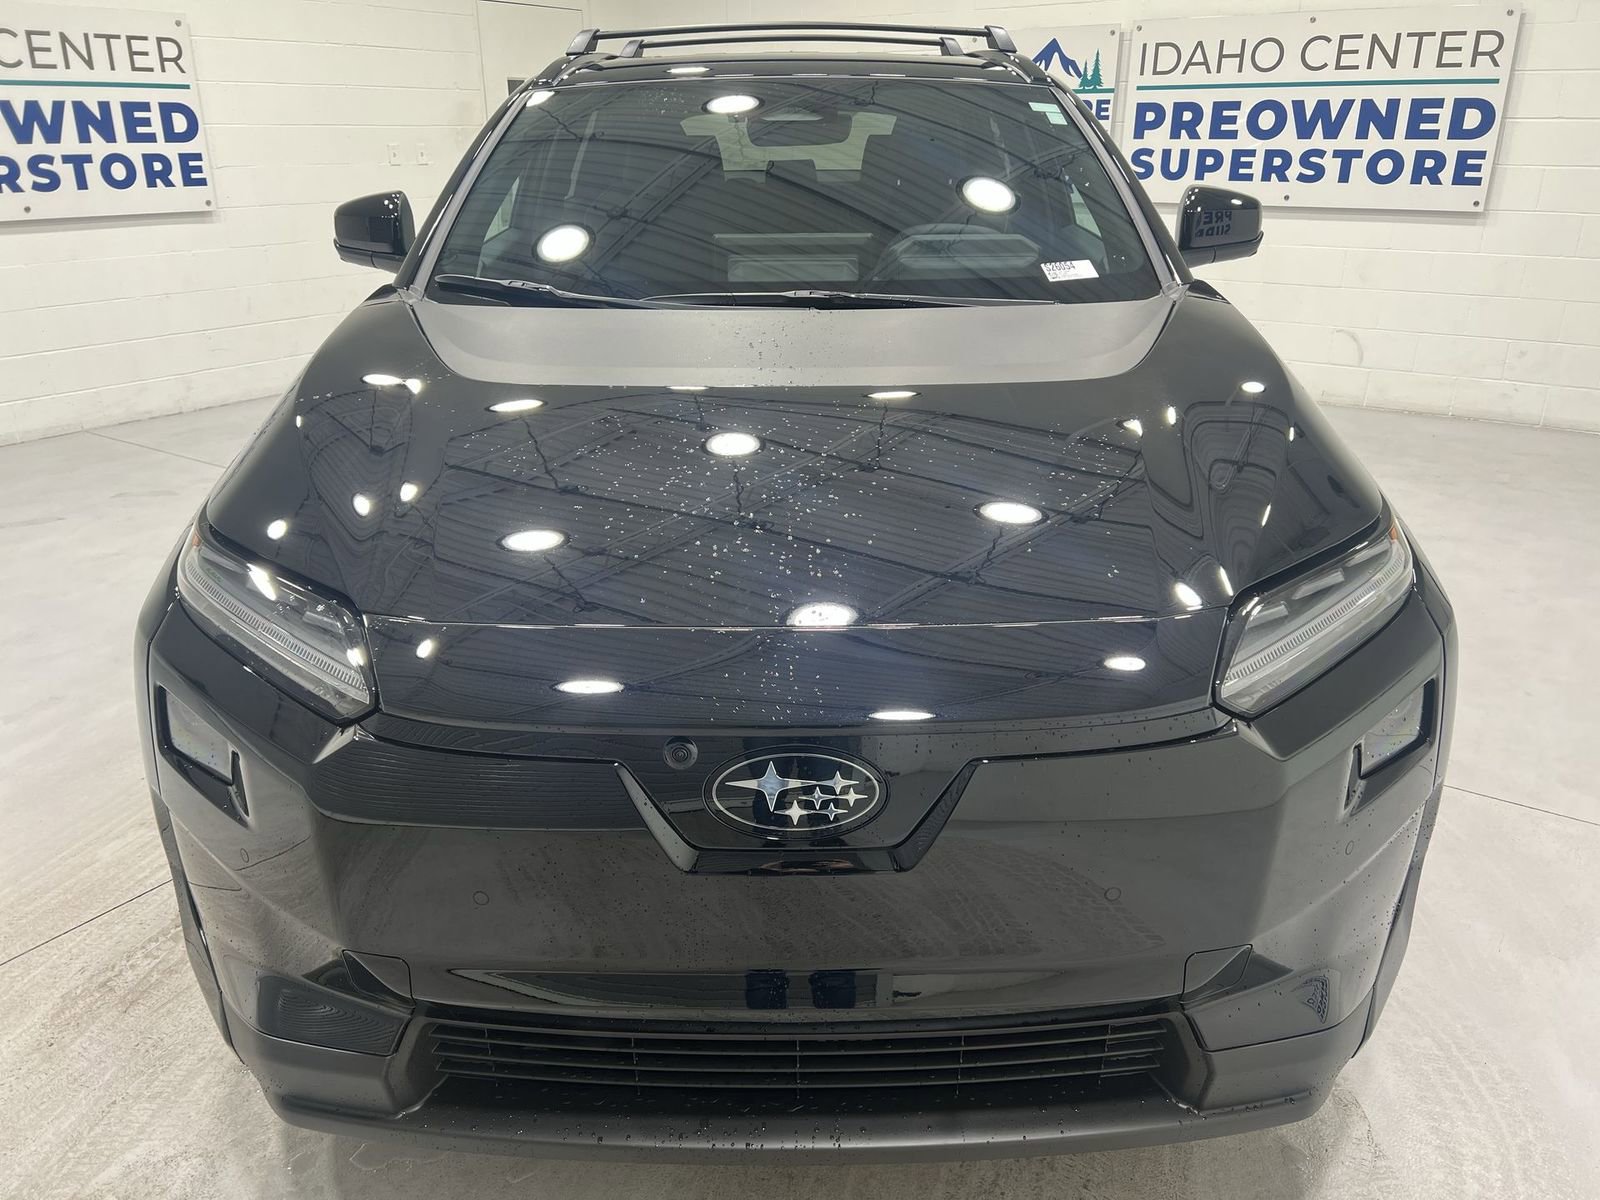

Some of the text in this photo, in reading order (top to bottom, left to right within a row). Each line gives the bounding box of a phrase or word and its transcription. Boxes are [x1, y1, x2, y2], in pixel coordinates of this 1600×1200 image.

[1139, 29, 1505, 76] IDAHO CENTER
[1132, 97, 1498, 141] PREOWNED
[1131, 147, 1487, 186] SUPERSTORE
